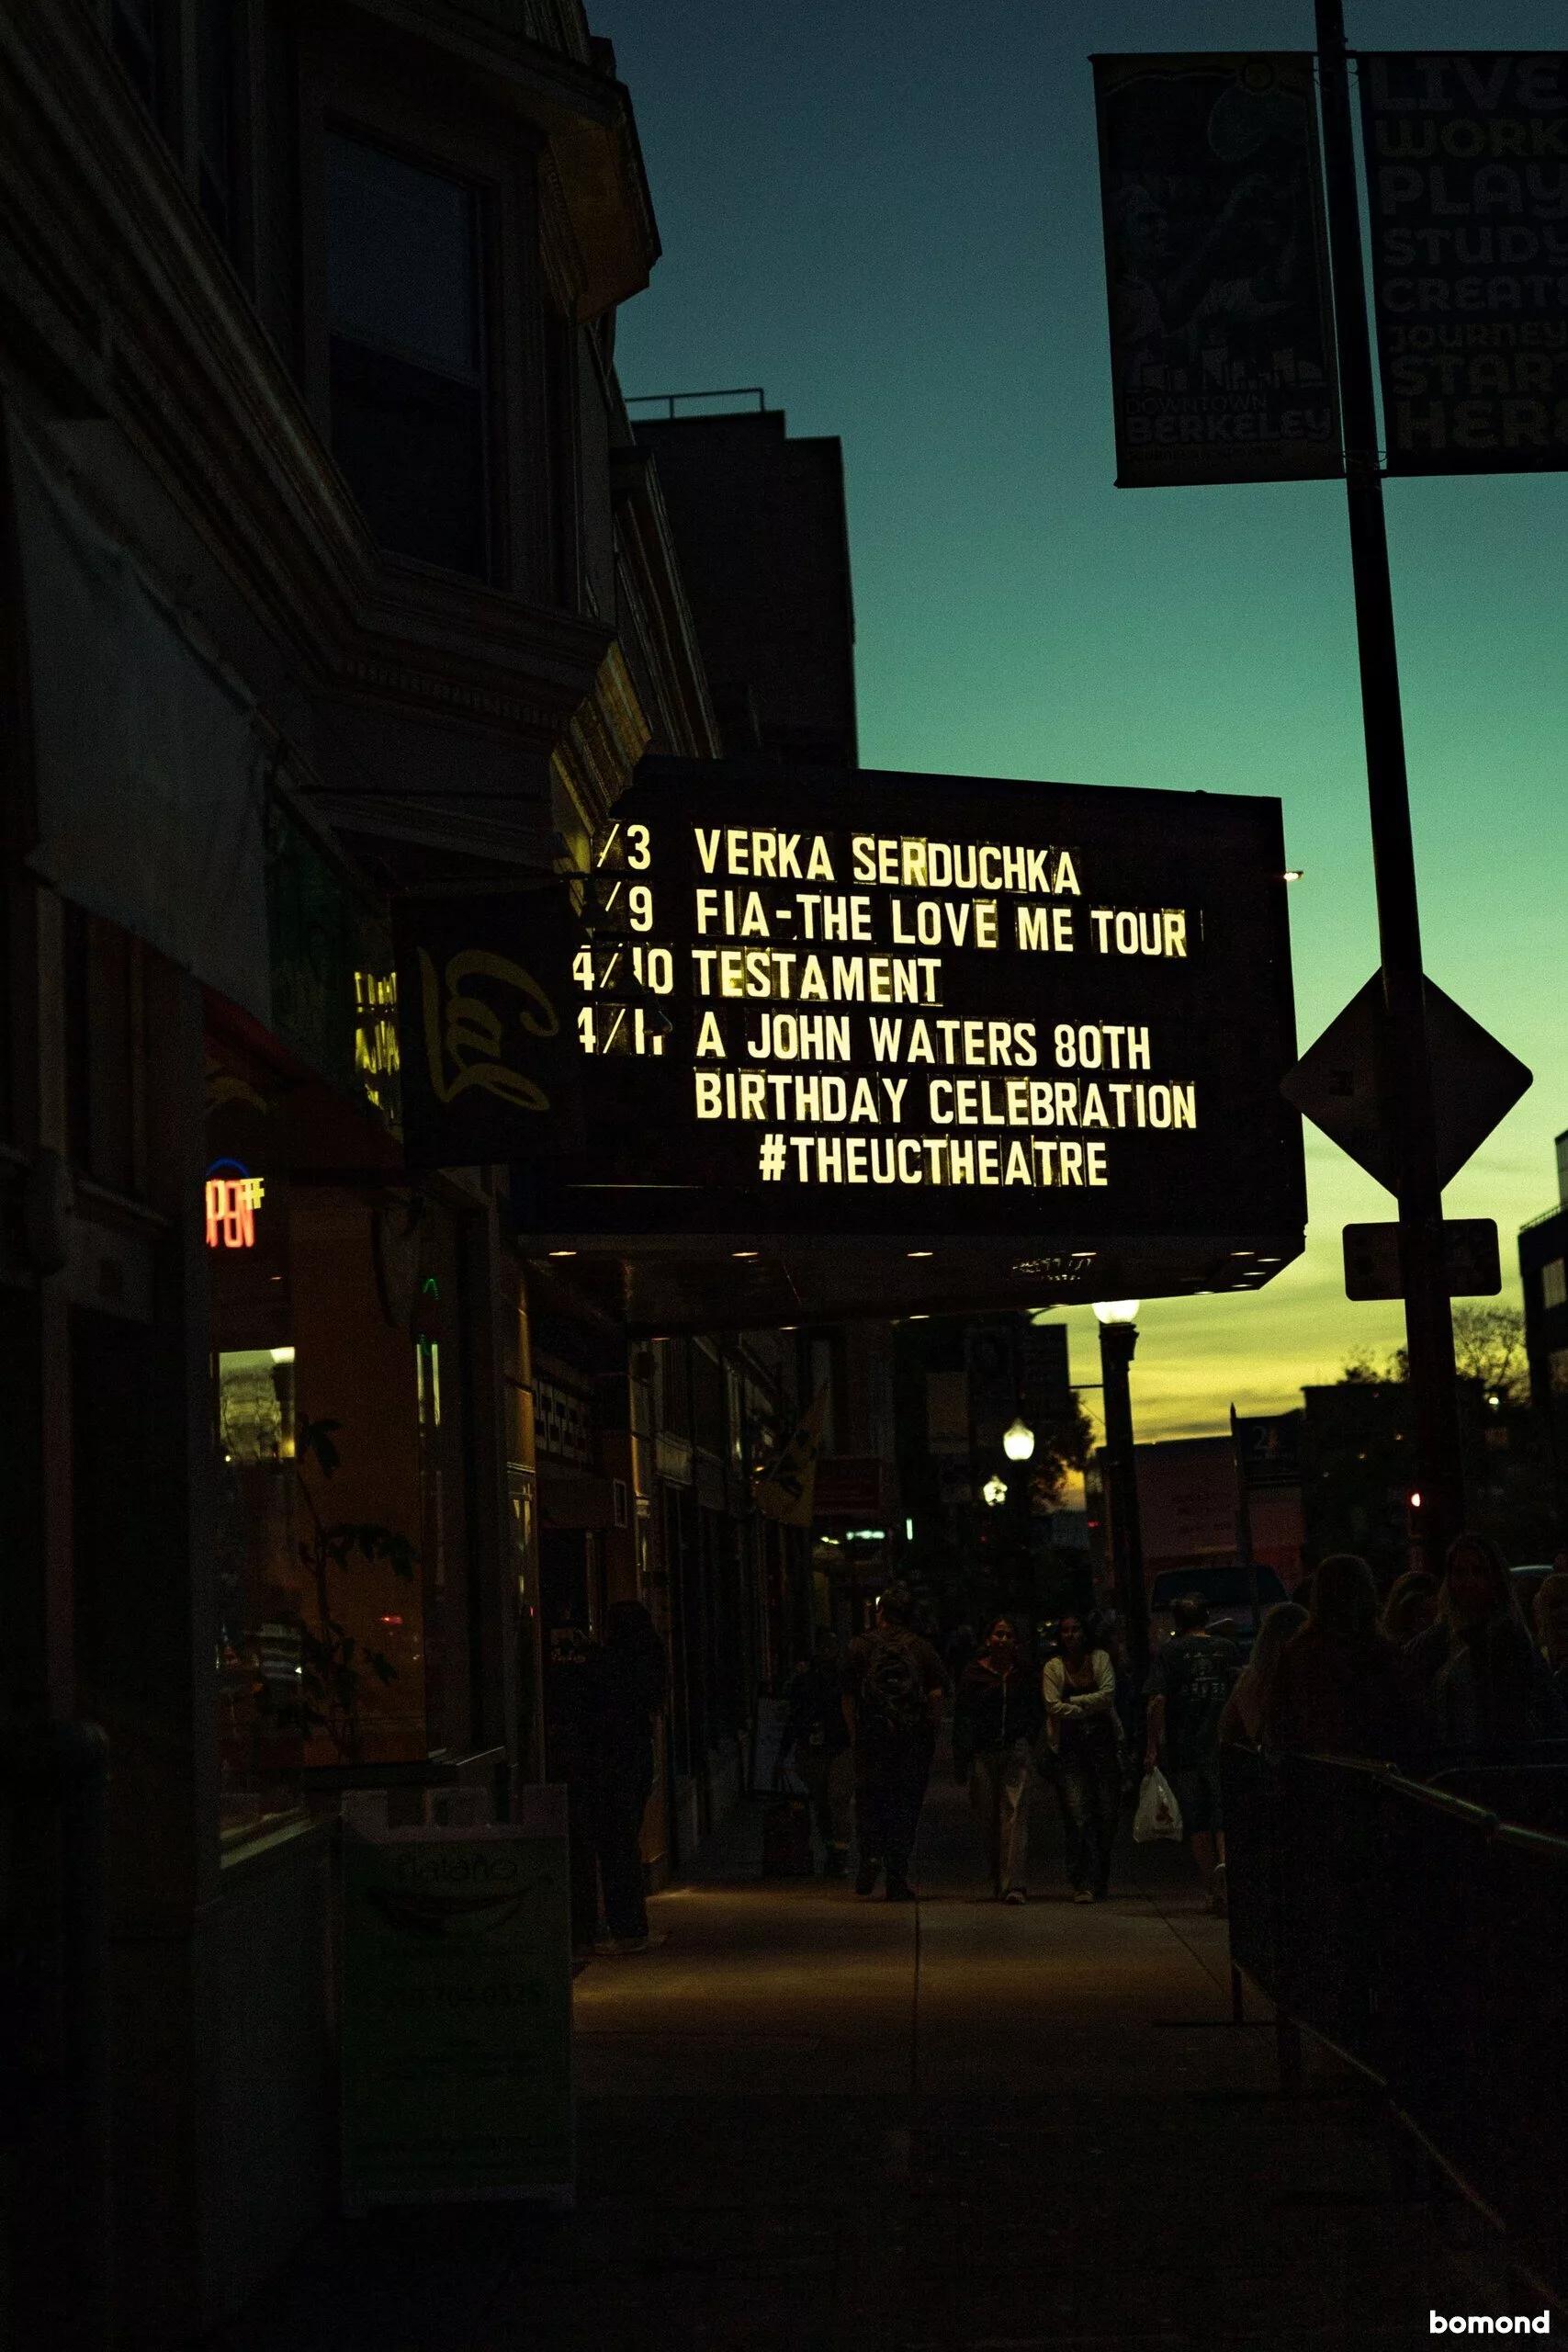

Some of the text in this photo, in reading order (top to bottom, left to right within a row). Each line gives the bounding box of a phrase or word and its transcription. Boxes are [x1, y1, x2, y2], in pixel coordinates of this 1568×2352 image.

[1370, 56, 1568, 111] LIVE
[1374, 118, 1568, 159] WORK
[1379, 163, 1568, 220] PLAY
[1125, 395, 1268, 415] DOWNTOWN
[1126, 407, 1332, 445] BERKELEY
[694, 828, 1081, 896] VERKA SERDUCHKA
[696, 888, 1187, 957] FIA-THE LOVE ME TOUR
[691, 949, 942, 1003] TESTAMENT
[416, 944, 558, 1113] Cal
[696, 1011, 1151, 1070] A JOHN WATERS 80TH
[694, 1072, 1197, 1129] BIRTHDAY CELEBRATION
[759, 1134, 1108, 1186] #THEUCTHEATRE
